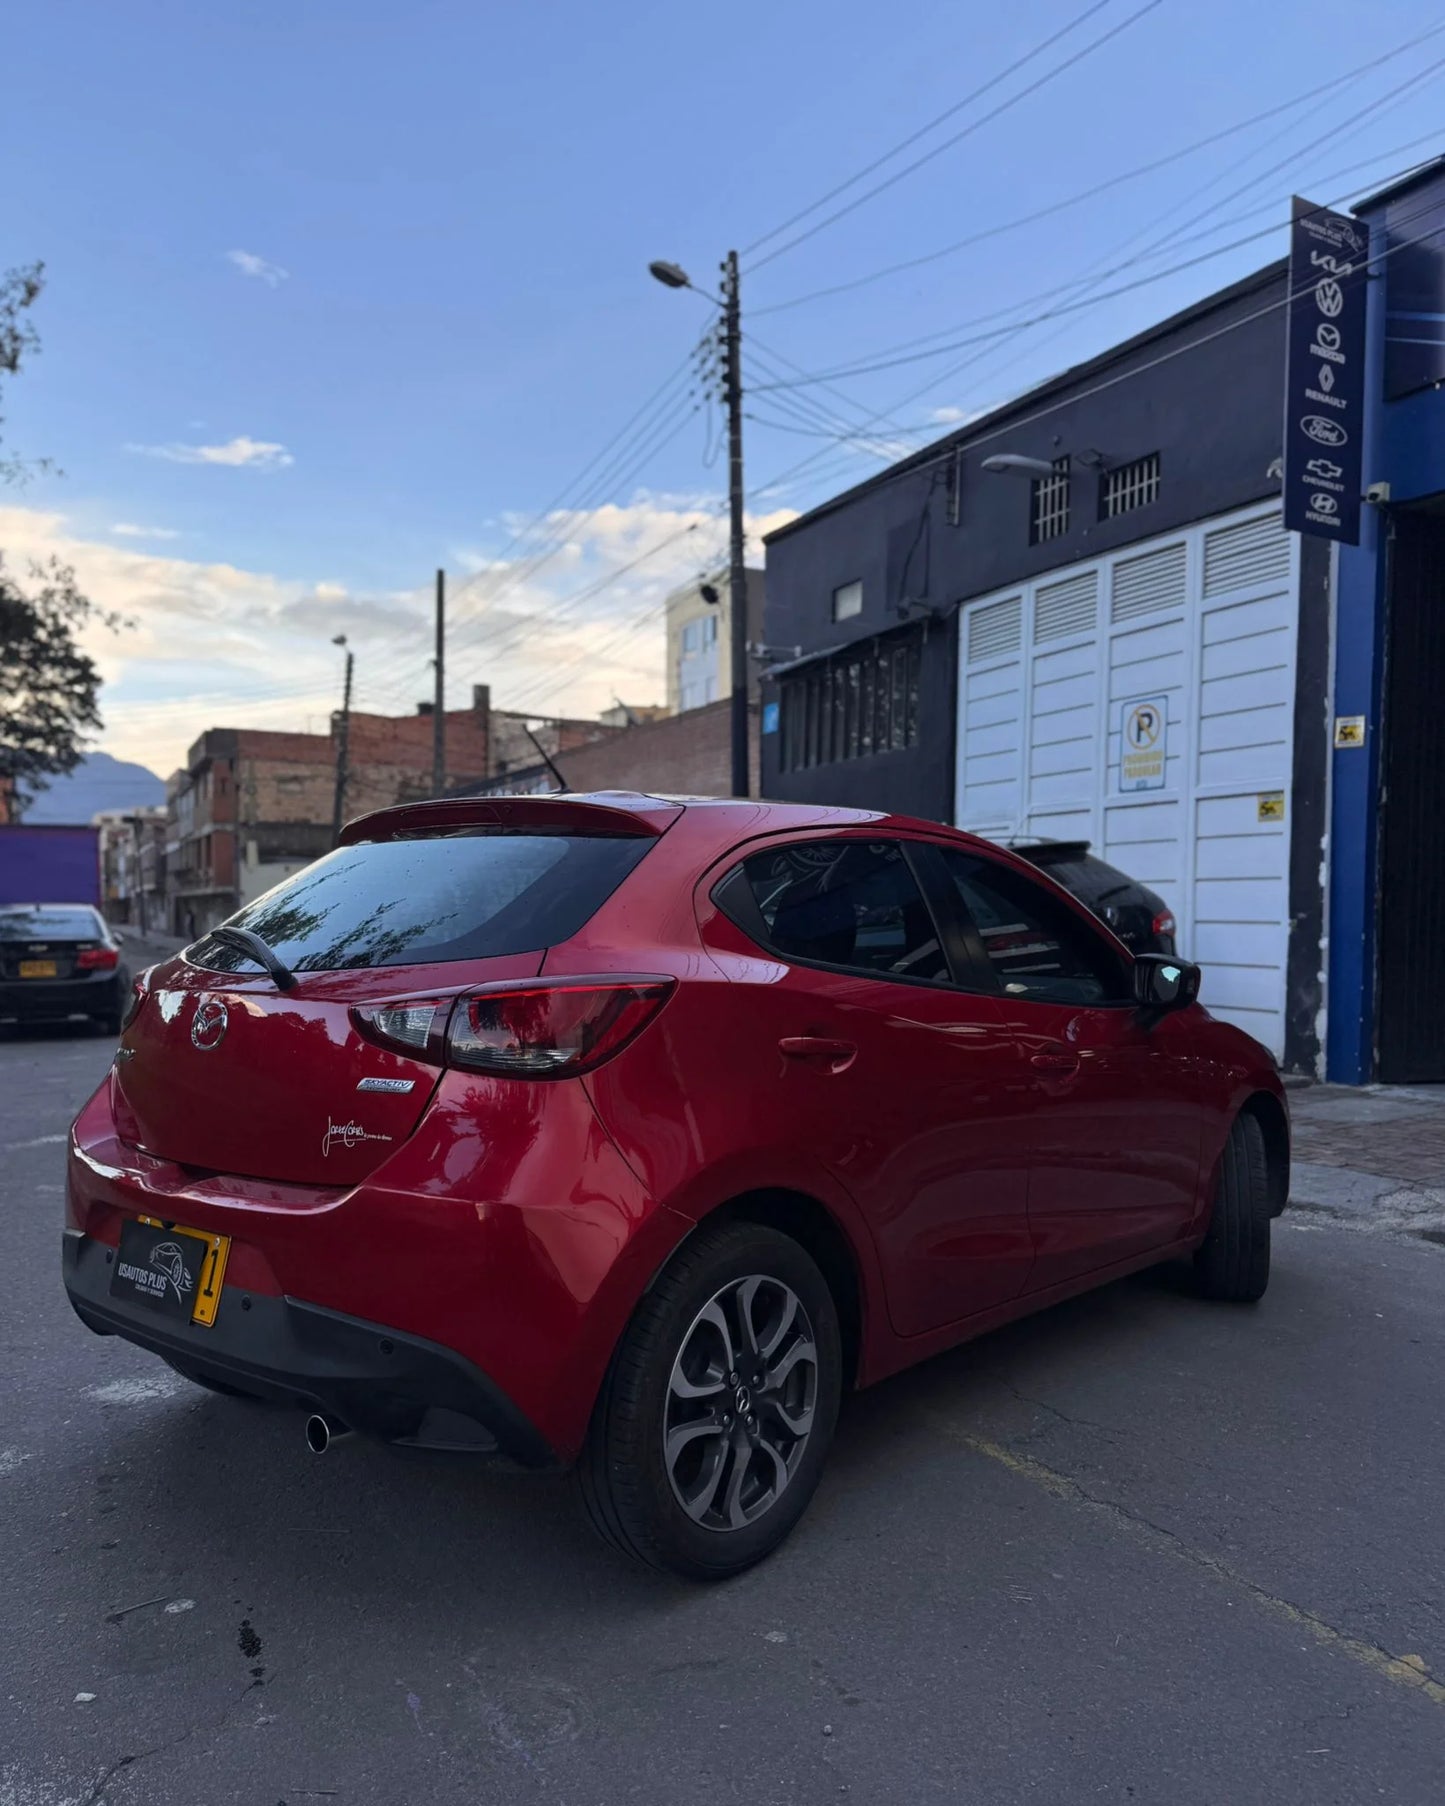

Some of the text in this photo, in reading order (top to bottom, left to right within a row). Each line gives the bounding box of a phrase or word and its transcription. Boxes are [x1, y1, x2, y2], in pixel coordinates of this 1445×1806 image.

[1305, 388, 1347, 409] RENAULT
[1309, 419, 1340, 442] Ford
[1302, 474, 1345, 493] CHEVROLET
[1305, 511, 1341, 527] HYUNDAI
[364, 1079, 410, 1089] SKYACTIV
[118, 1263, 167, 1290] USAUTOS PLUS
